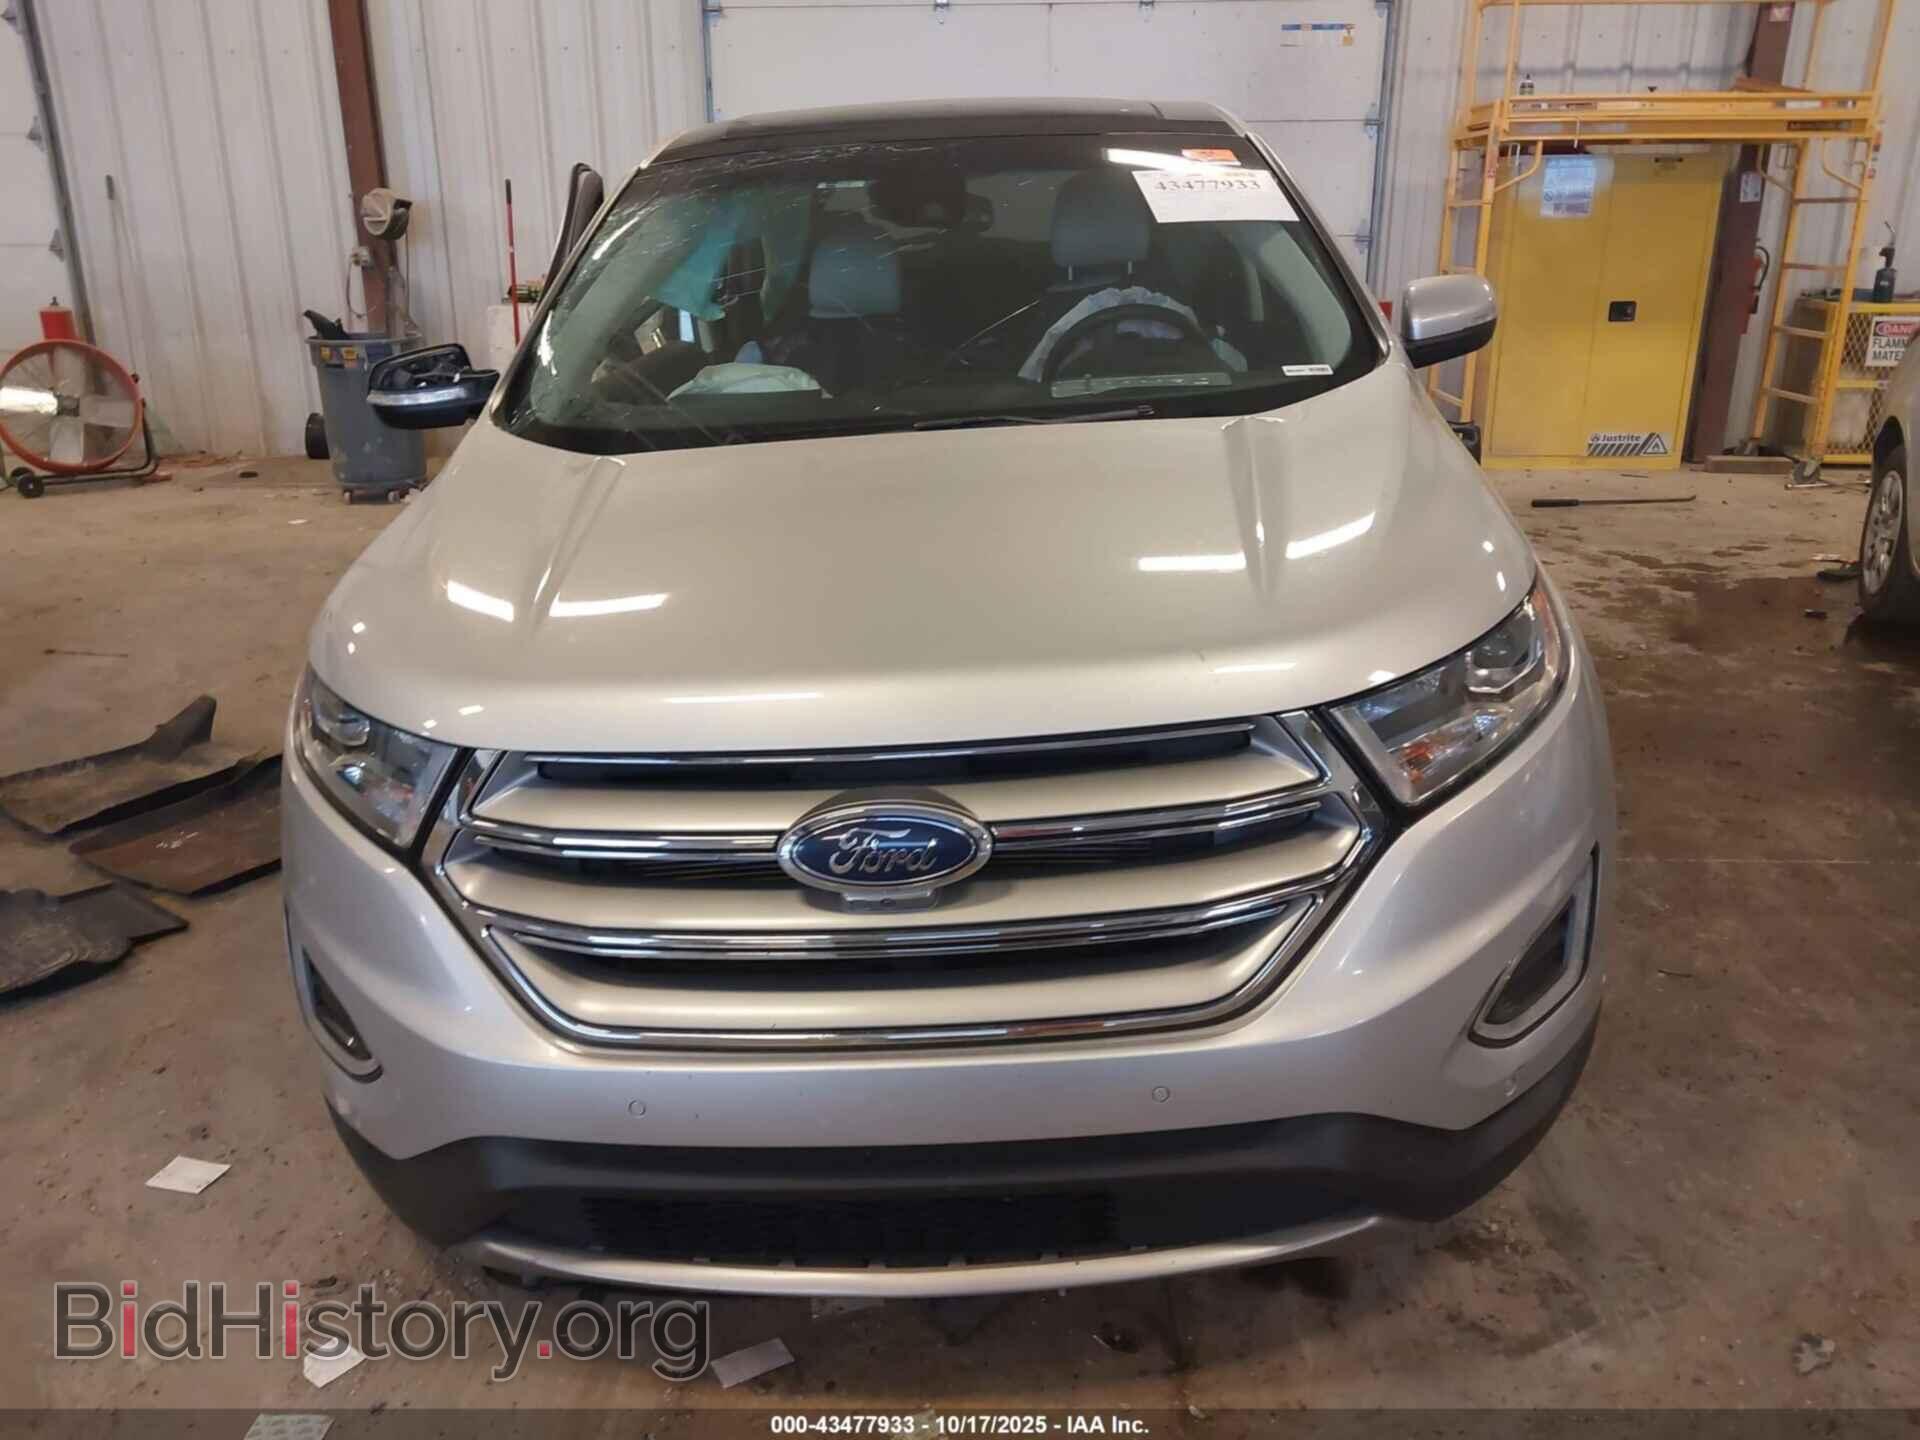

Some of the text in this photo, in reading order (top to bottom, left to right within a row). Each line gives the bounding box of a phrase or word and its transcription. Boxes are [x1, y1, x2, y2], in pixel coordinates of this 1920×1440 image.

[1154, 179, 1262, 191] 43477933
[1602, 433, 1641, 442] Justrite
[821, 827, 938, 874] Ford
